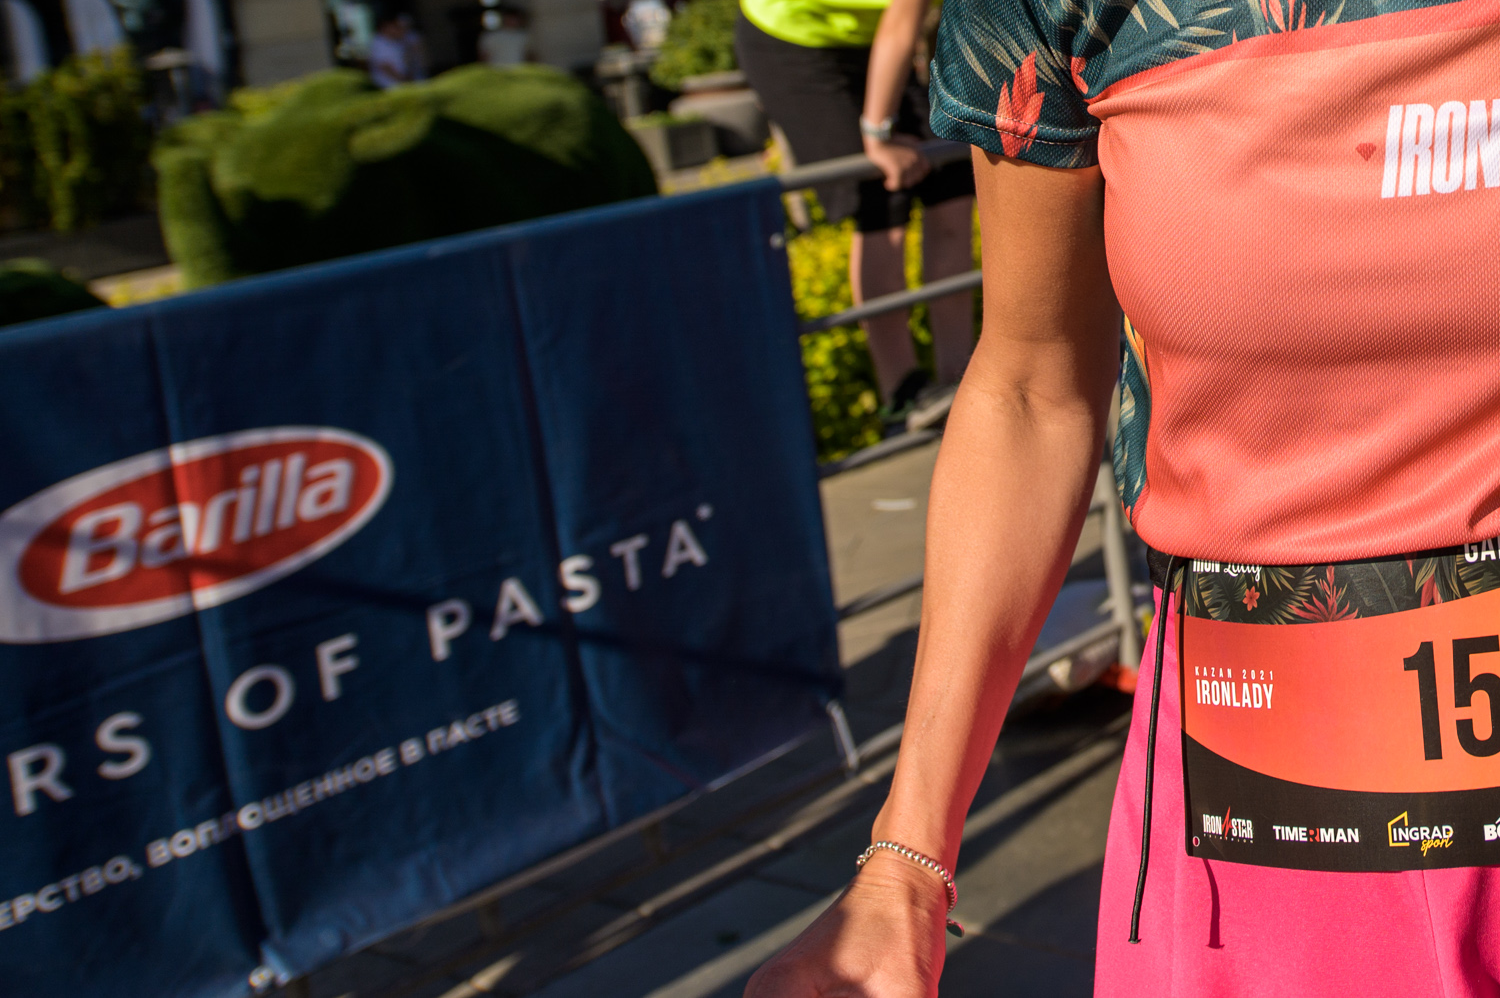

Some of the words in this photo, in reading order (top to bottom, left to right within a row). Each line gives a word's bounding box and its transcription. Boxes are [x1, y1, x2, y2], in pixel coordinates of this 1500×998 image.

[59, 452, 355, 595] Barilla
[224, 633, 361, 730] OF
[1195, 666, 1232, 679] KAZAN
[1242, 669, 1273, 681] 2021
[1196, 679, 1273, 709] IRONLADY
[425, 699, 520, 756] ПАСТЕ
[1203, 813, 1222, 835] IRON
[1231, 818, 1253, 839] STAR
[1392, 825, 1453, 843] INGRAD
[1420, 838, 1454, 857] sport
